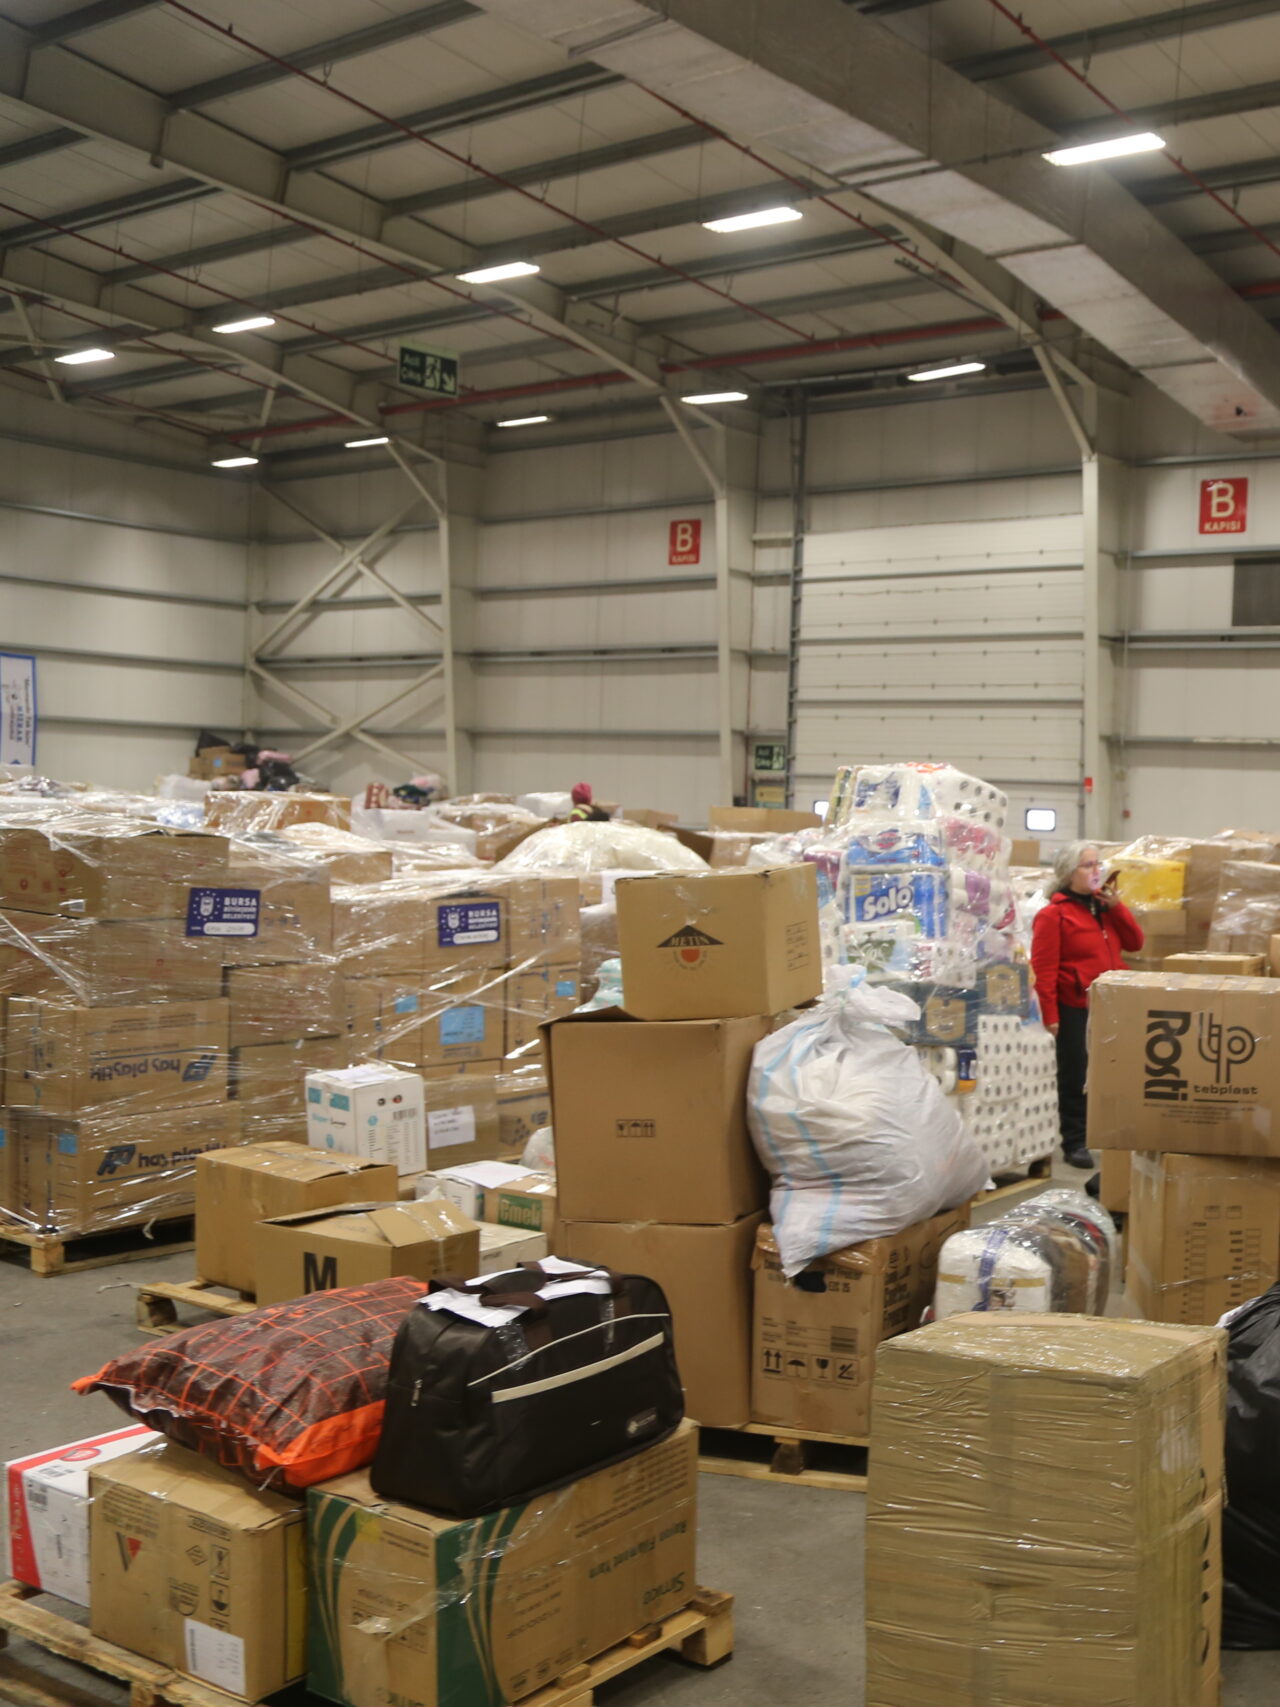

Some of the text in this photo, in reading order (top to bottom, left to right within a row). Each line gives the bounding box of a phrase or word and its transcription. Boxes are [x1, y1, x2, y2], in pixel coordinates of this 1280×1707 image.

[1211, 482, 1235, 518] B
[676, 523, 693, 552] B
[223, 897, 257, 906] BURSA
[863, 886, 914, 921] Solo
[1144, 1009, 1192, 1101] Rosti
[1193, 1084, 1259, 1095] tebplast
[303, 1251, 338, 1295] M
